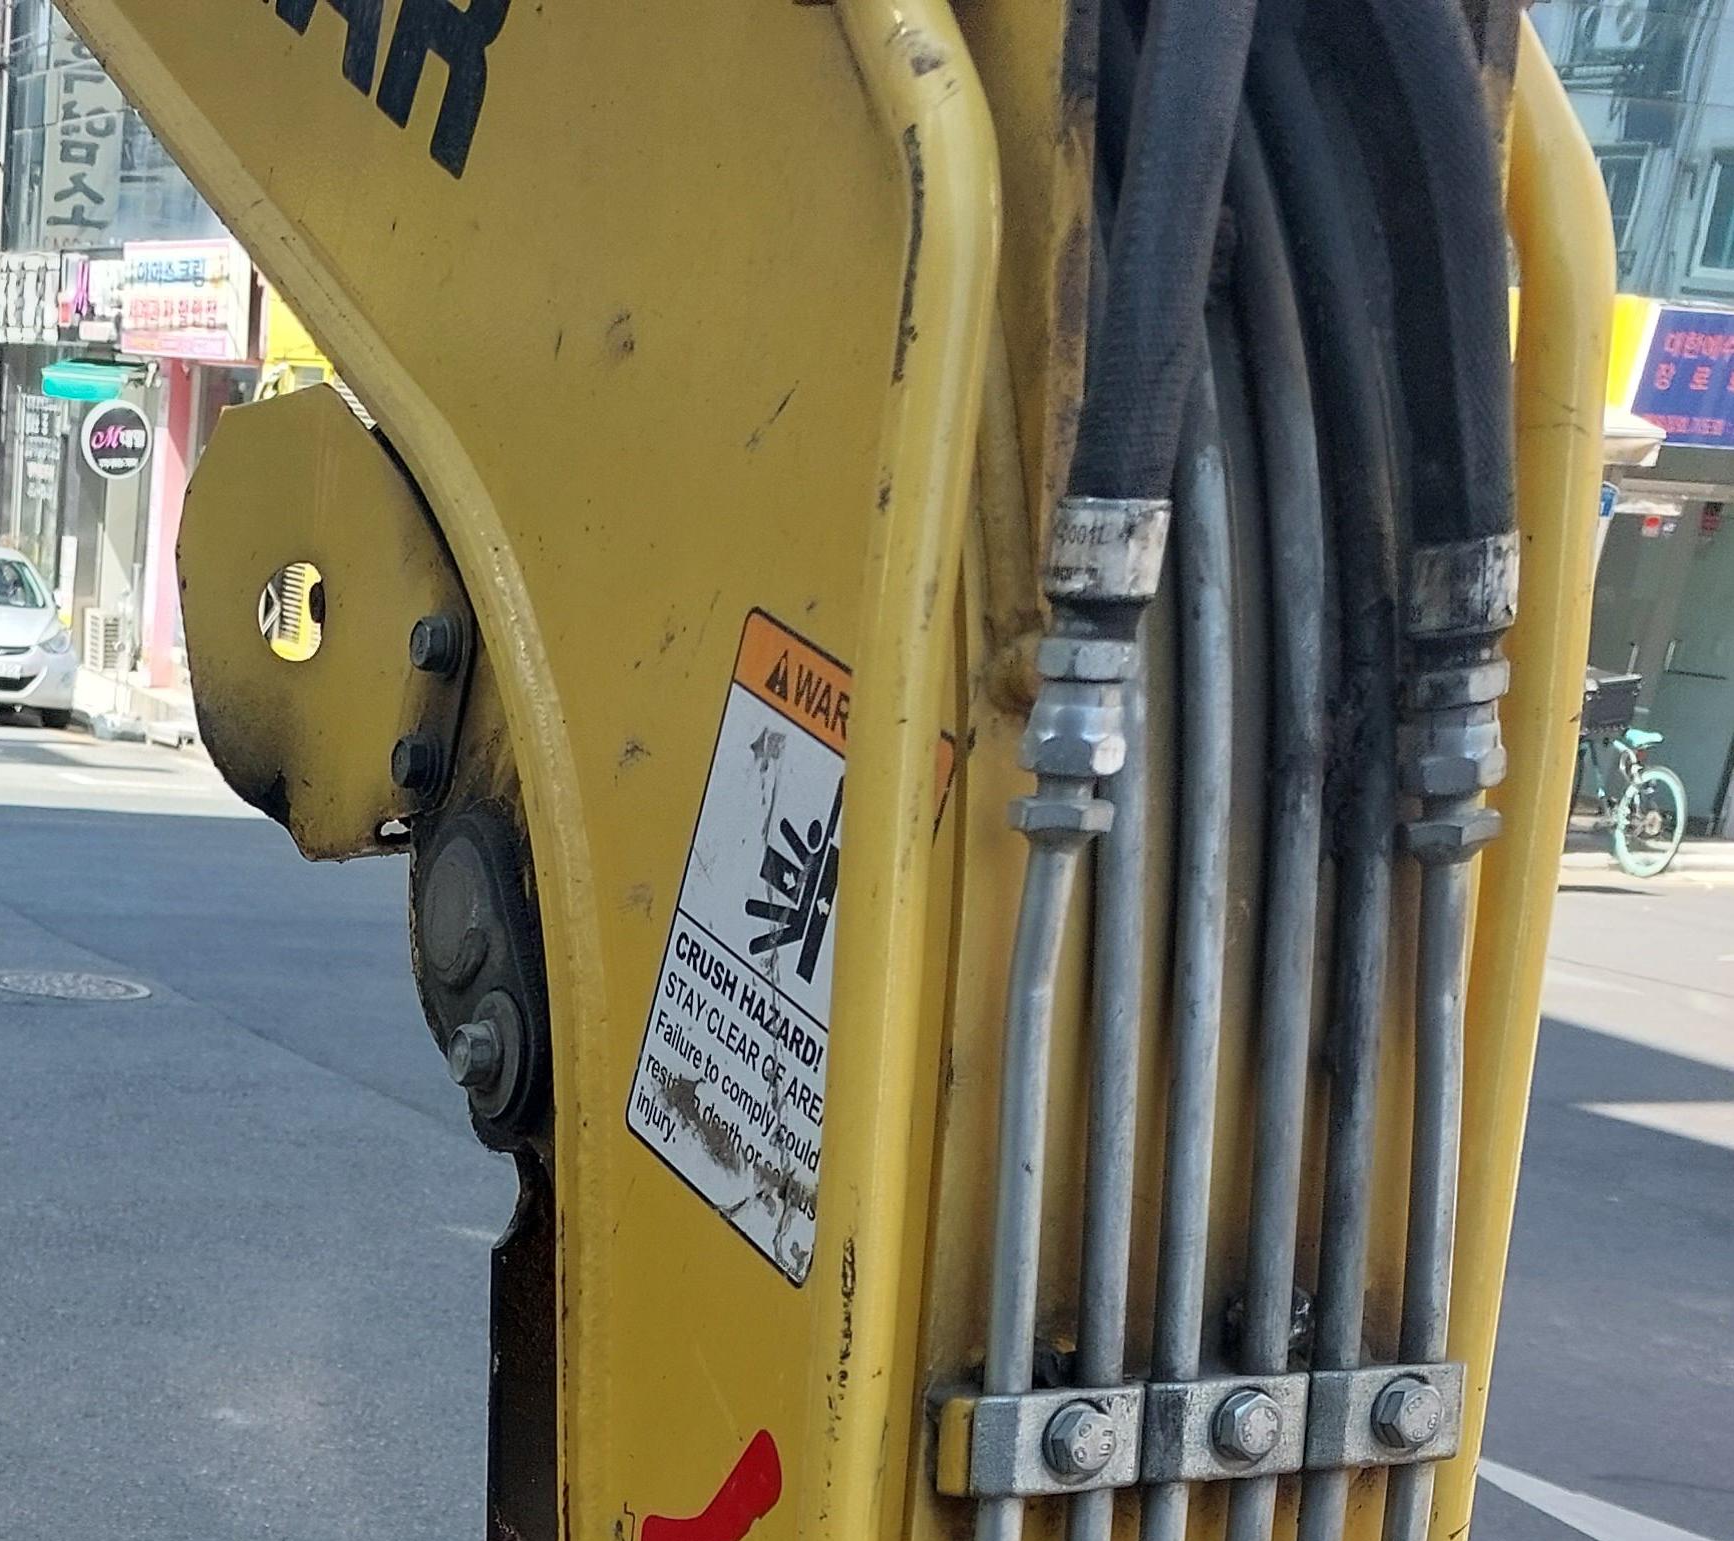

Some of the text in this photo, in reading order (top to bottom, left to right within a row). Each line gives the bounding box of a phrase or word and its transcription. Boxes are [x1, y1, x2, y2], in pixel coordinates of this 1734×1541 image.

[665, 971, 824, 1128] STAY CLEAR OF ARE
[675, 931, 825, 1073] CRUSH HAZARD!
[637, 1086, 678, 1144] injury.
[655, 1009, 703, 1069] Failure
[704, 1054, 720, 1084] to
[721, 1074, 775, 1137] comply
[744, 1145, 763, 1165] or
